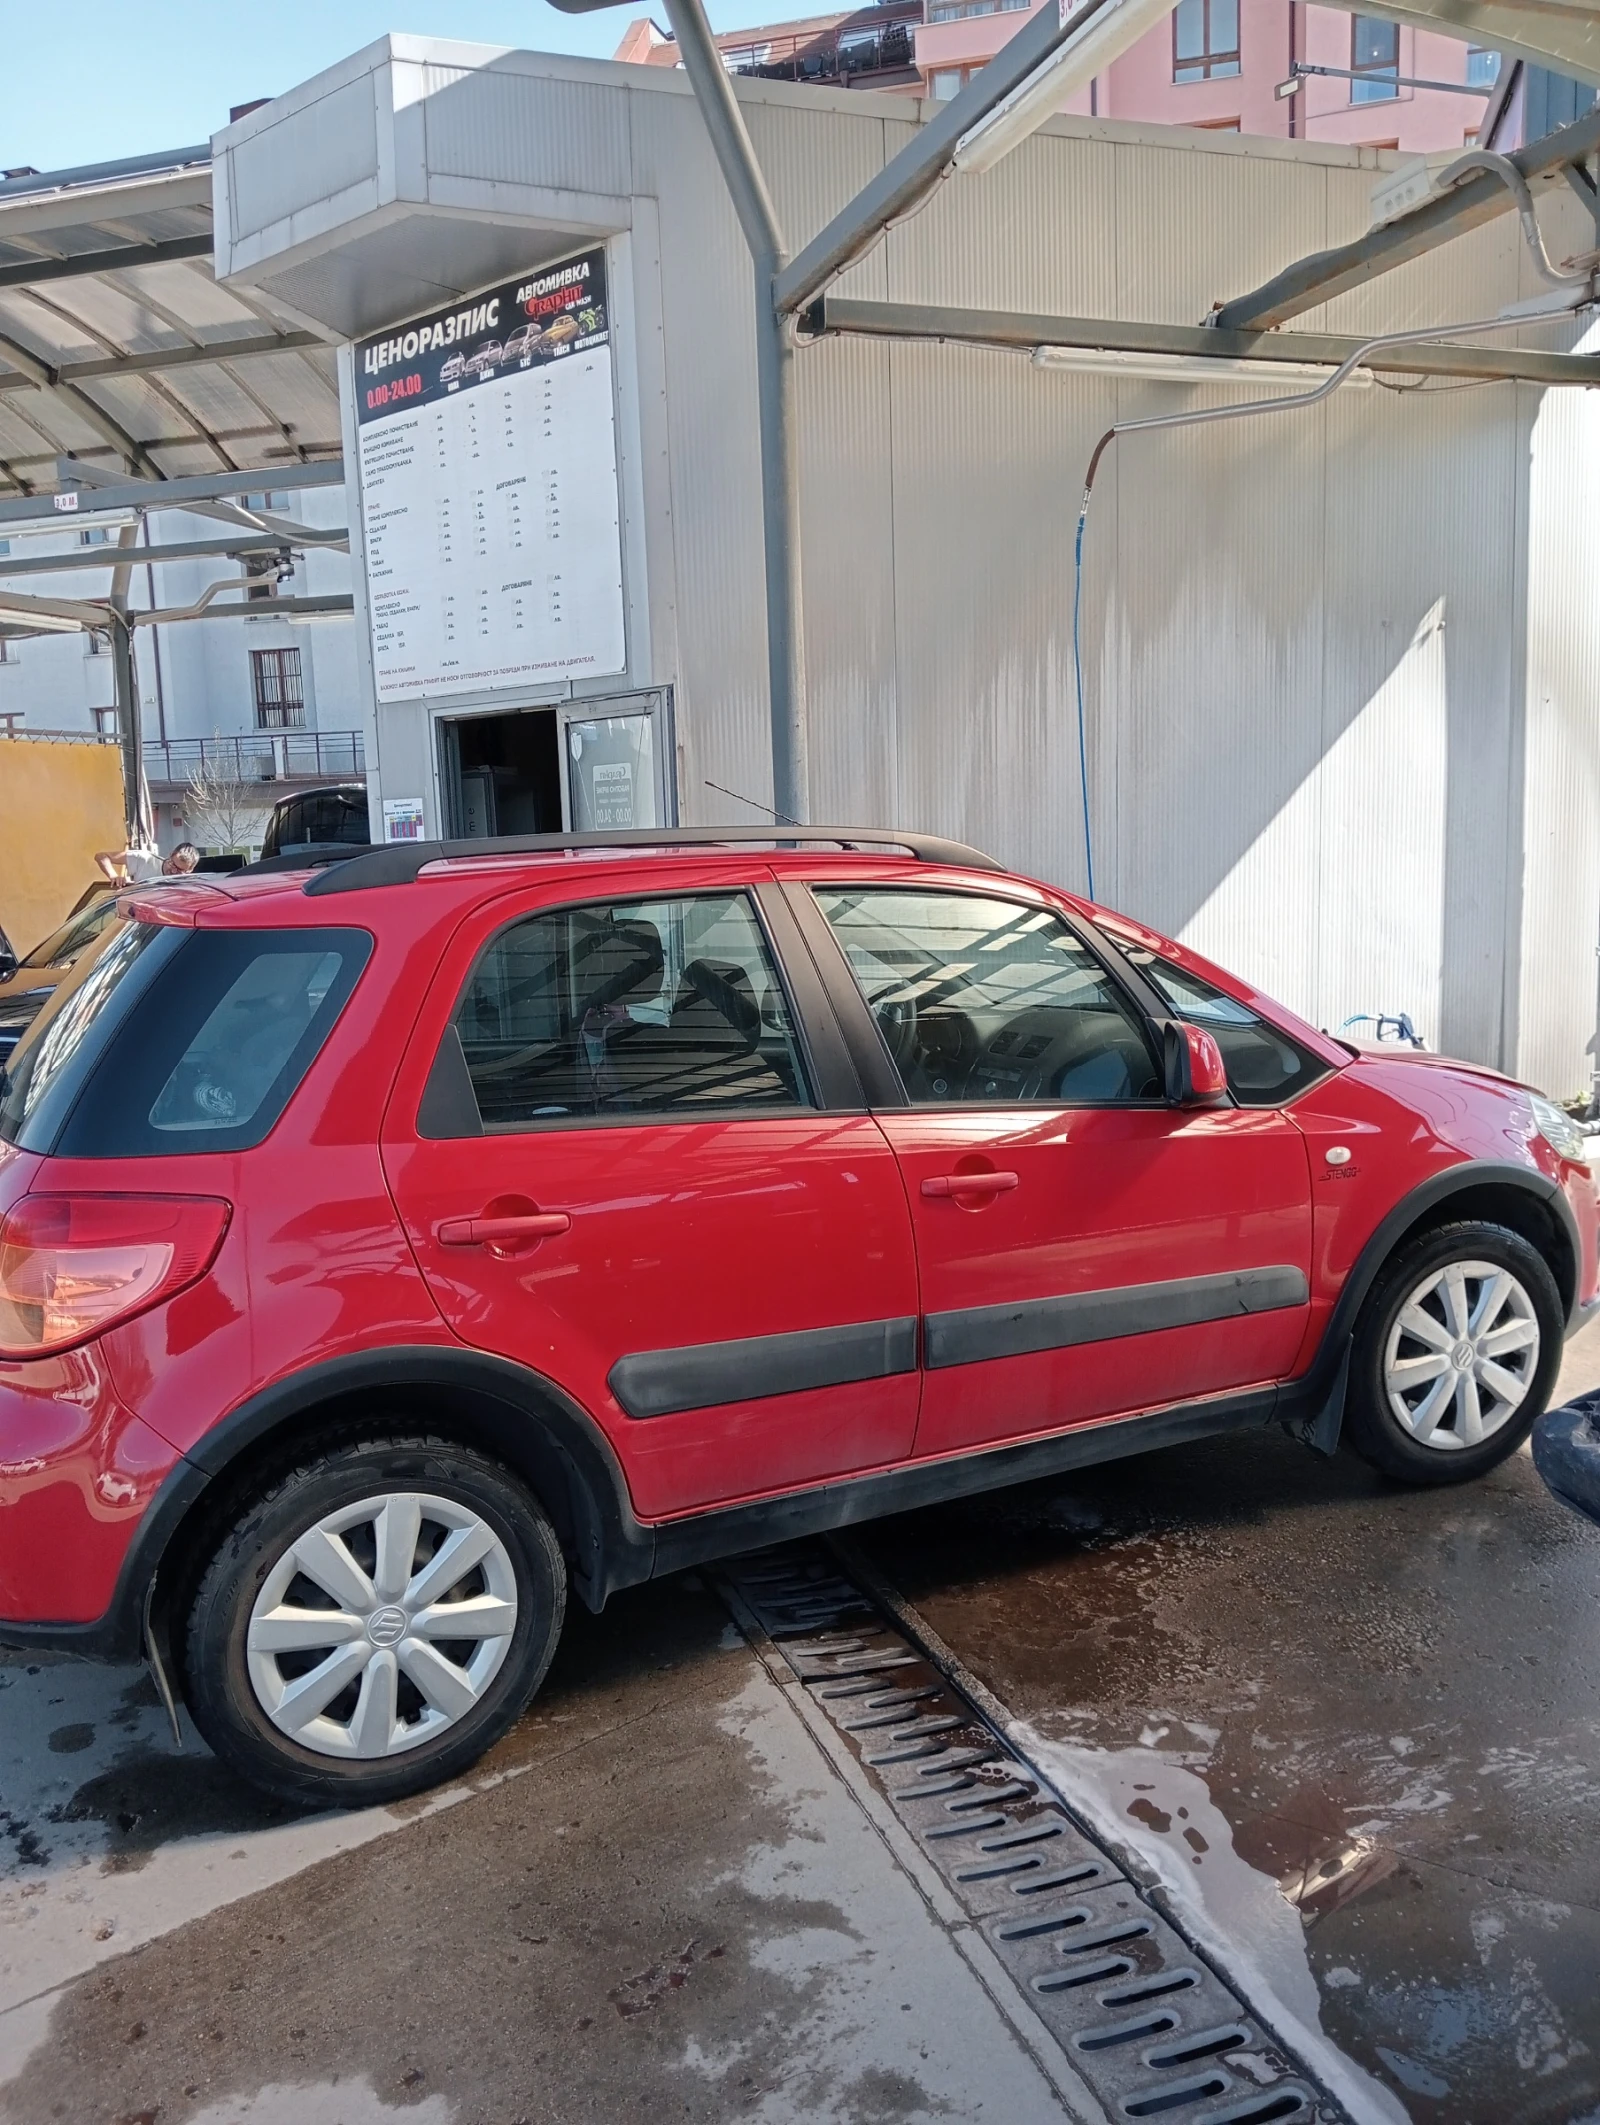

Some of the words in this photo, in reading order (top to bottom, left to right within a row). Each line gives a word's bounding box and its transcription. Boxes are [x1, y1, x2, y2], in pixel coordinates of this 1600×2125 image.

[516, 261, 590, 304] АВТОМИВКА
[577, 295, 592, 307] WASH
[364, 298, 500, 376] ЦЕНОРАЗПИС
[520, 357, 531, 368] БУС
[553, 344, 570, 358] ТАКСИ
[574, 330, 609, 350] МОТОЦИКЛЕТ
[367, 373, 422, 409] 0.00-24.00
[496, 476, 526, 491] ДОГОВАРЯНЕ
[502, 580, 532, 592] ДОГОВАРЯНЕ
[460, 670, 492, 680] ОТГОВОРНОСТ
[531, 660, 558, 670] ИЗМИВАНЕ
